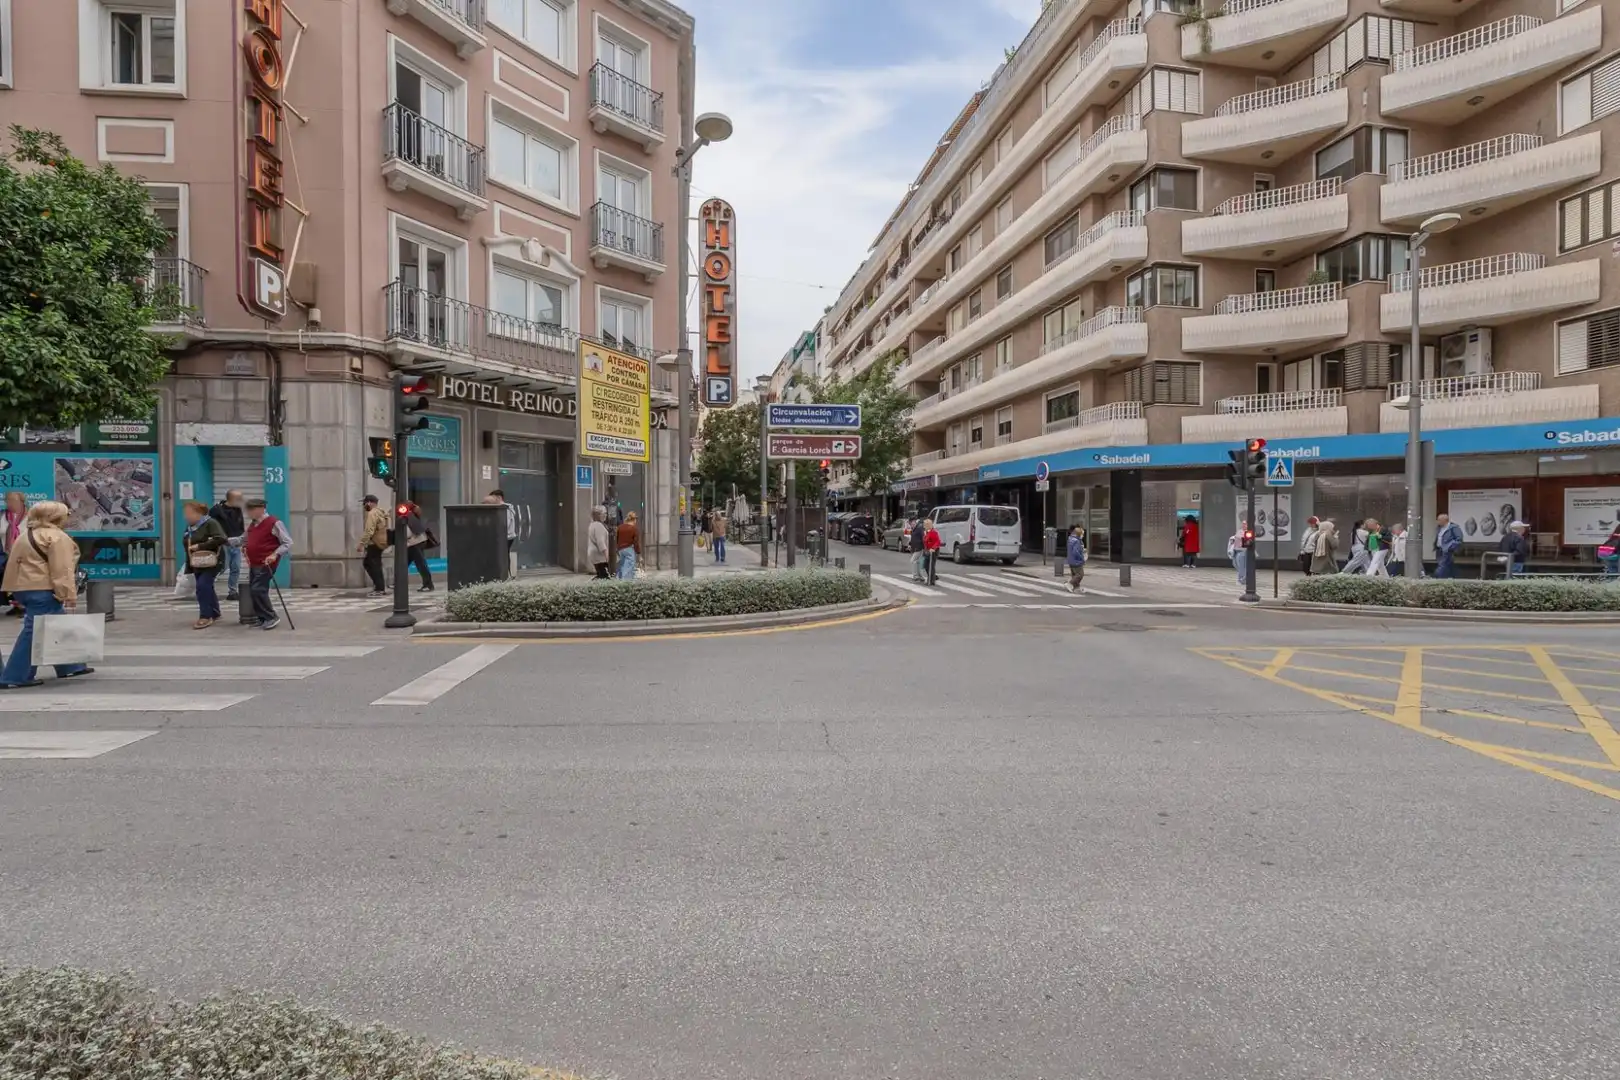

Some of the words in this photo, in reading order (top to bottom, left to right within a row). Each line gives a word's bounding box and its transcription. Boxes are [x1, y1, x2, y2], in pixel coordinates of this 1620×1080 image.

[260, 263, 281, 305] P
[704, 219, 731, 374] HOTEL
[606, 374, 620, 384] POR
[611, 366, 640, 381] CONTROL
[437, 375, 505, 405] HOTEL
[508, 390, 564, 414] REINO
[567, 399, 577, 416] D
[603, 388, 637, 404] RECOGIDAS
[710, 381, 728, 401] P
[593, 399, 631, 414] RESTRINGIDA
[632, 408, 640, 417] AL
[772, 408, 832, 416] Circunvalación
[650, 411, 668, 429] DA
[411, 436, 457, 451] TORRES
[1100, 453, 1150, 465] Sabadell
[1261, 446, 1320, 458] Sabadell
[266, 466, 284, 483] 53
[83, 567, 132, 576] s.com
